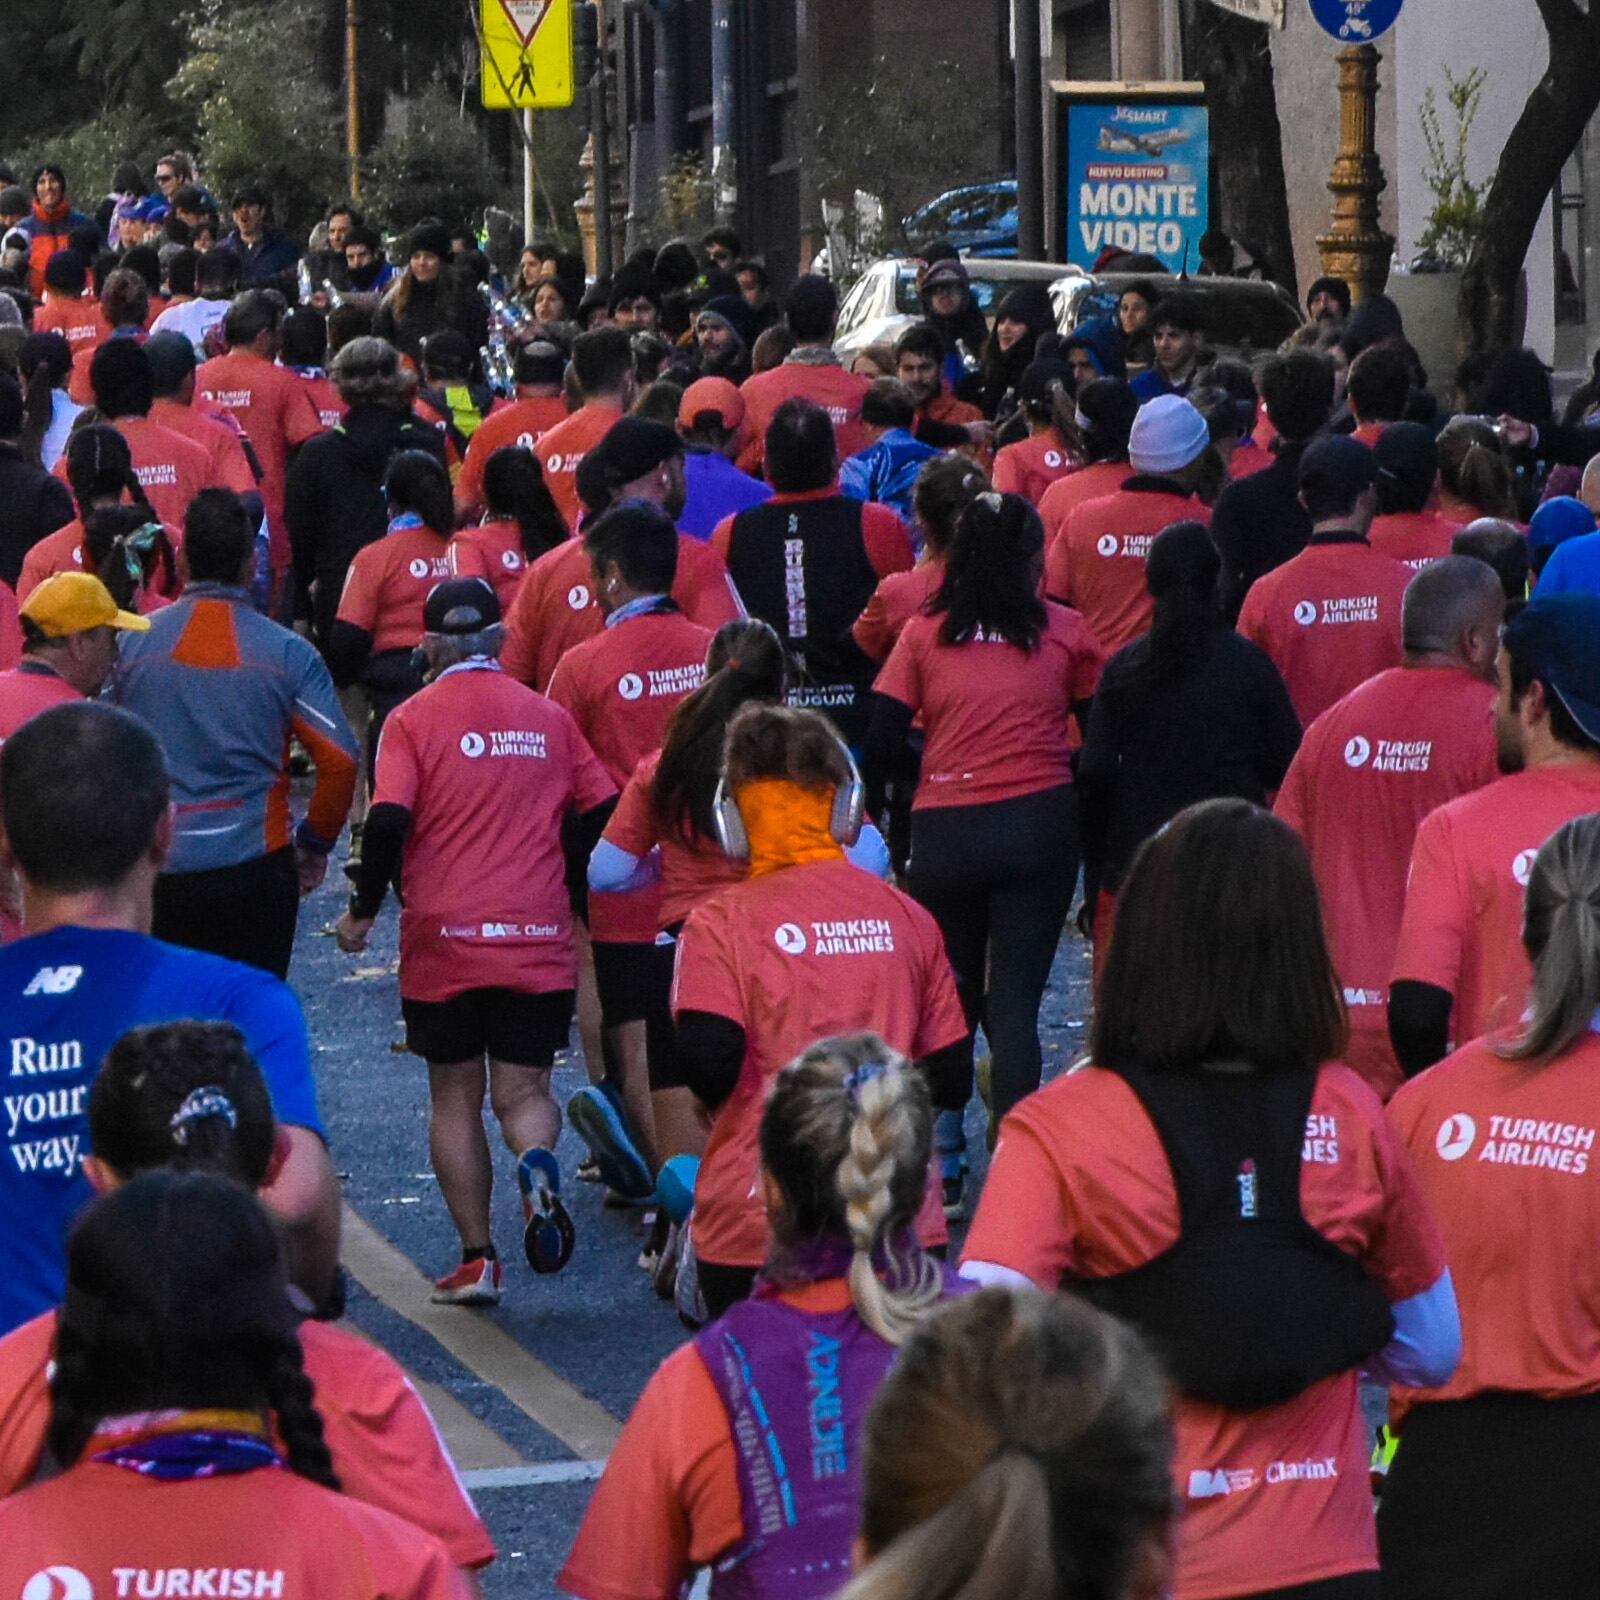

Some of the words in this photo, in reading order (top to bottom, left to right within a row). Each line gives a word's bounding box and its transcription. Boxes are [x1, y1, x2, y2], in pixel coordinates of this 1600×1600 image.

[1089, 166, 1122, 178] NUEVO
[1124, 166, 1165, 179] DESTINO
[1079, 182, 1198, 217] MONTE
[1079, 220, 1183, 254] VIDEO
[1122, 534, 1153, 546] TURK
[1321, 595, 1378, 612] TURKISH
[1321, 607, 1378, 625] AIRLINES
[647, 662, 706, 683] TURKISH
[785, 694, 856, 706] RUGUAY
[489, 731, 545, 746] TURKISH
[1375, 740, 1432, 757] TURKISH
[490, 742, 547, 759] AIRLINES
[1372, 755, 1431, 772] AIRLINES
[811, 919, 891, 938] TURKISH
[814, 935, 895, 956] AIRLINES
[9, 1037, 78, 1077] Run
[4, 1084, 84, 1138] your
[1489, 1115, 1596, 1150] TURKISH
[11, 1134, 86, 1177] way.
[1479, 1140, 1590, 1175] AIRLINES
[111, 1567, 285, 1599] TURKISH
